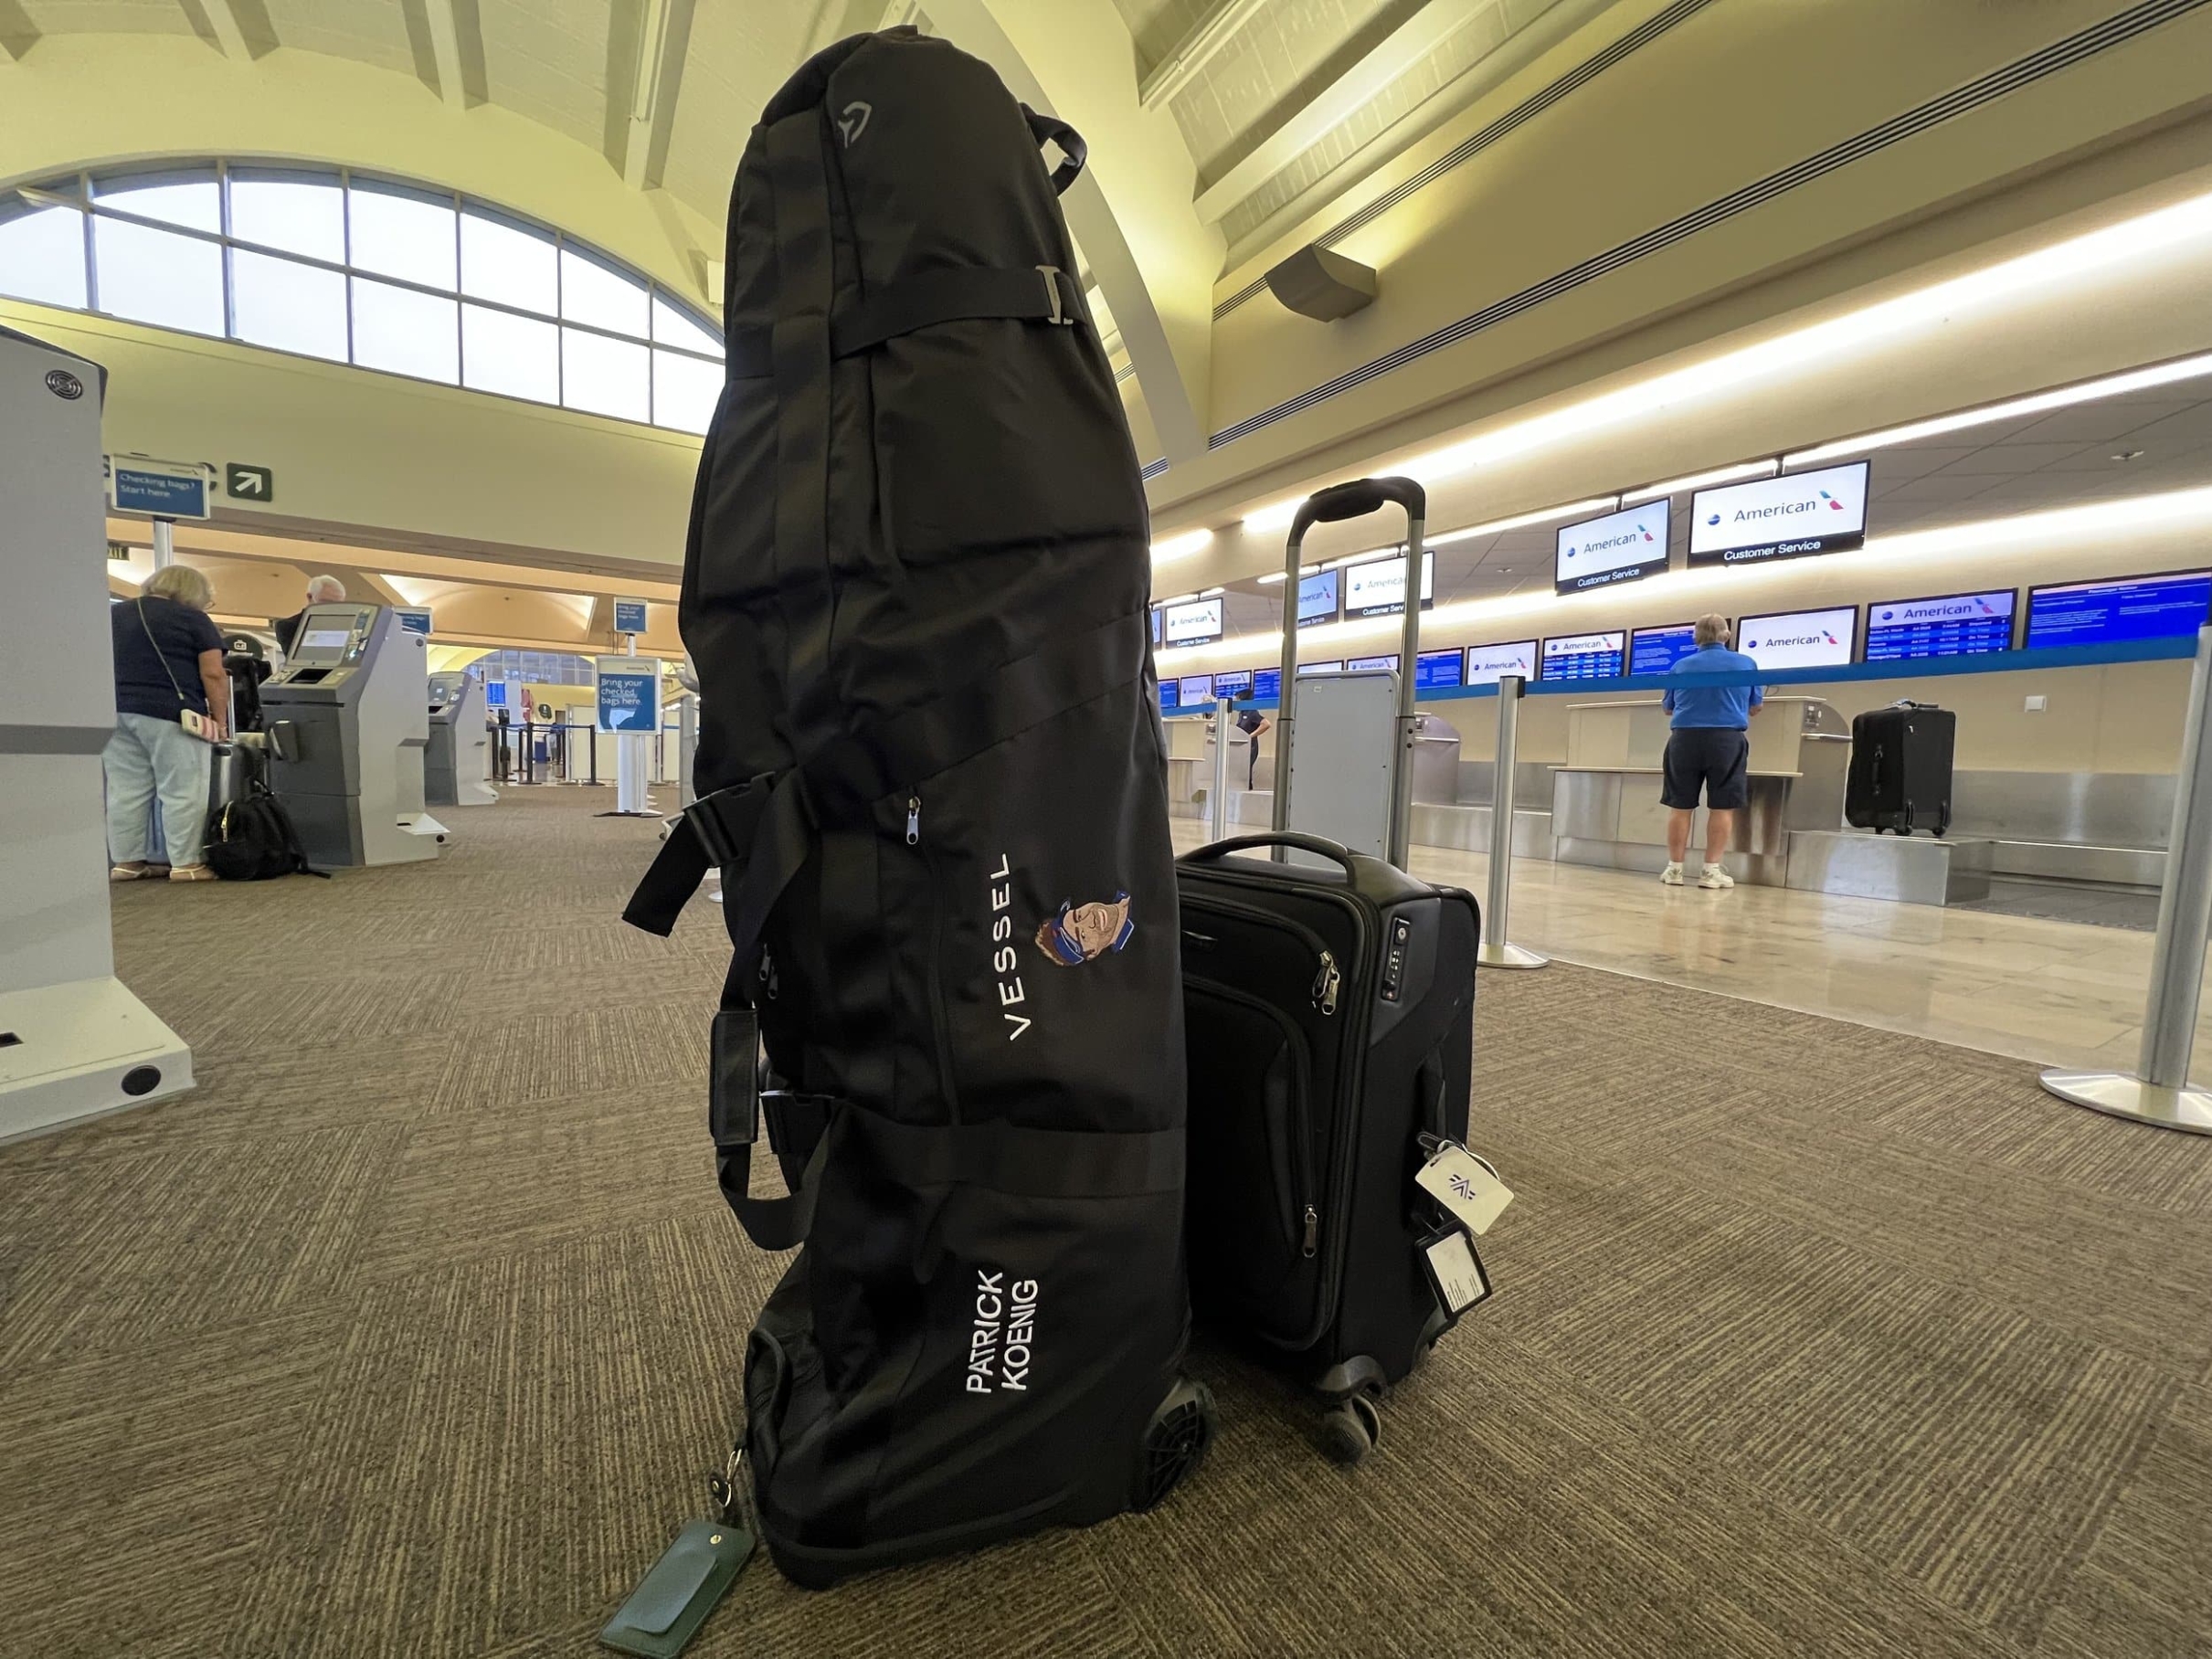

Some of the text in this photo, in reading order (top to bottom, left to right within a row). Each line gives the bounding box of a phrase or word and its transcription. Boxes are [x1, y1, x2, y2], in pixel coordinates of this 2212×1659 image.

[120, 473, 165, 488] Checking
[120, 485, 144, 495] Start
[1734, 501, 1816, 523] American
[1583, 533, 1636, 555] American
[1723, 540, 1821, 561] Customer Service
[1577, 567, 1640, 587] Customer Service
[1903, 604, 1972, 619] American
[1563, 640, 1602, 650] American
[1765, 636, 1820, 648] American
[1484, 661, 1517, 671] American
[601, 678, 643, 689] Bring your
[601, 687, 634, 695] checked
[601, 696, 620, 707] bags
[990, 853, 1032, 1041] VESSEL
[966, 1269, 1003, 1394] PATRICK
[1000, 1279, 1039, 1390] KOENIG
